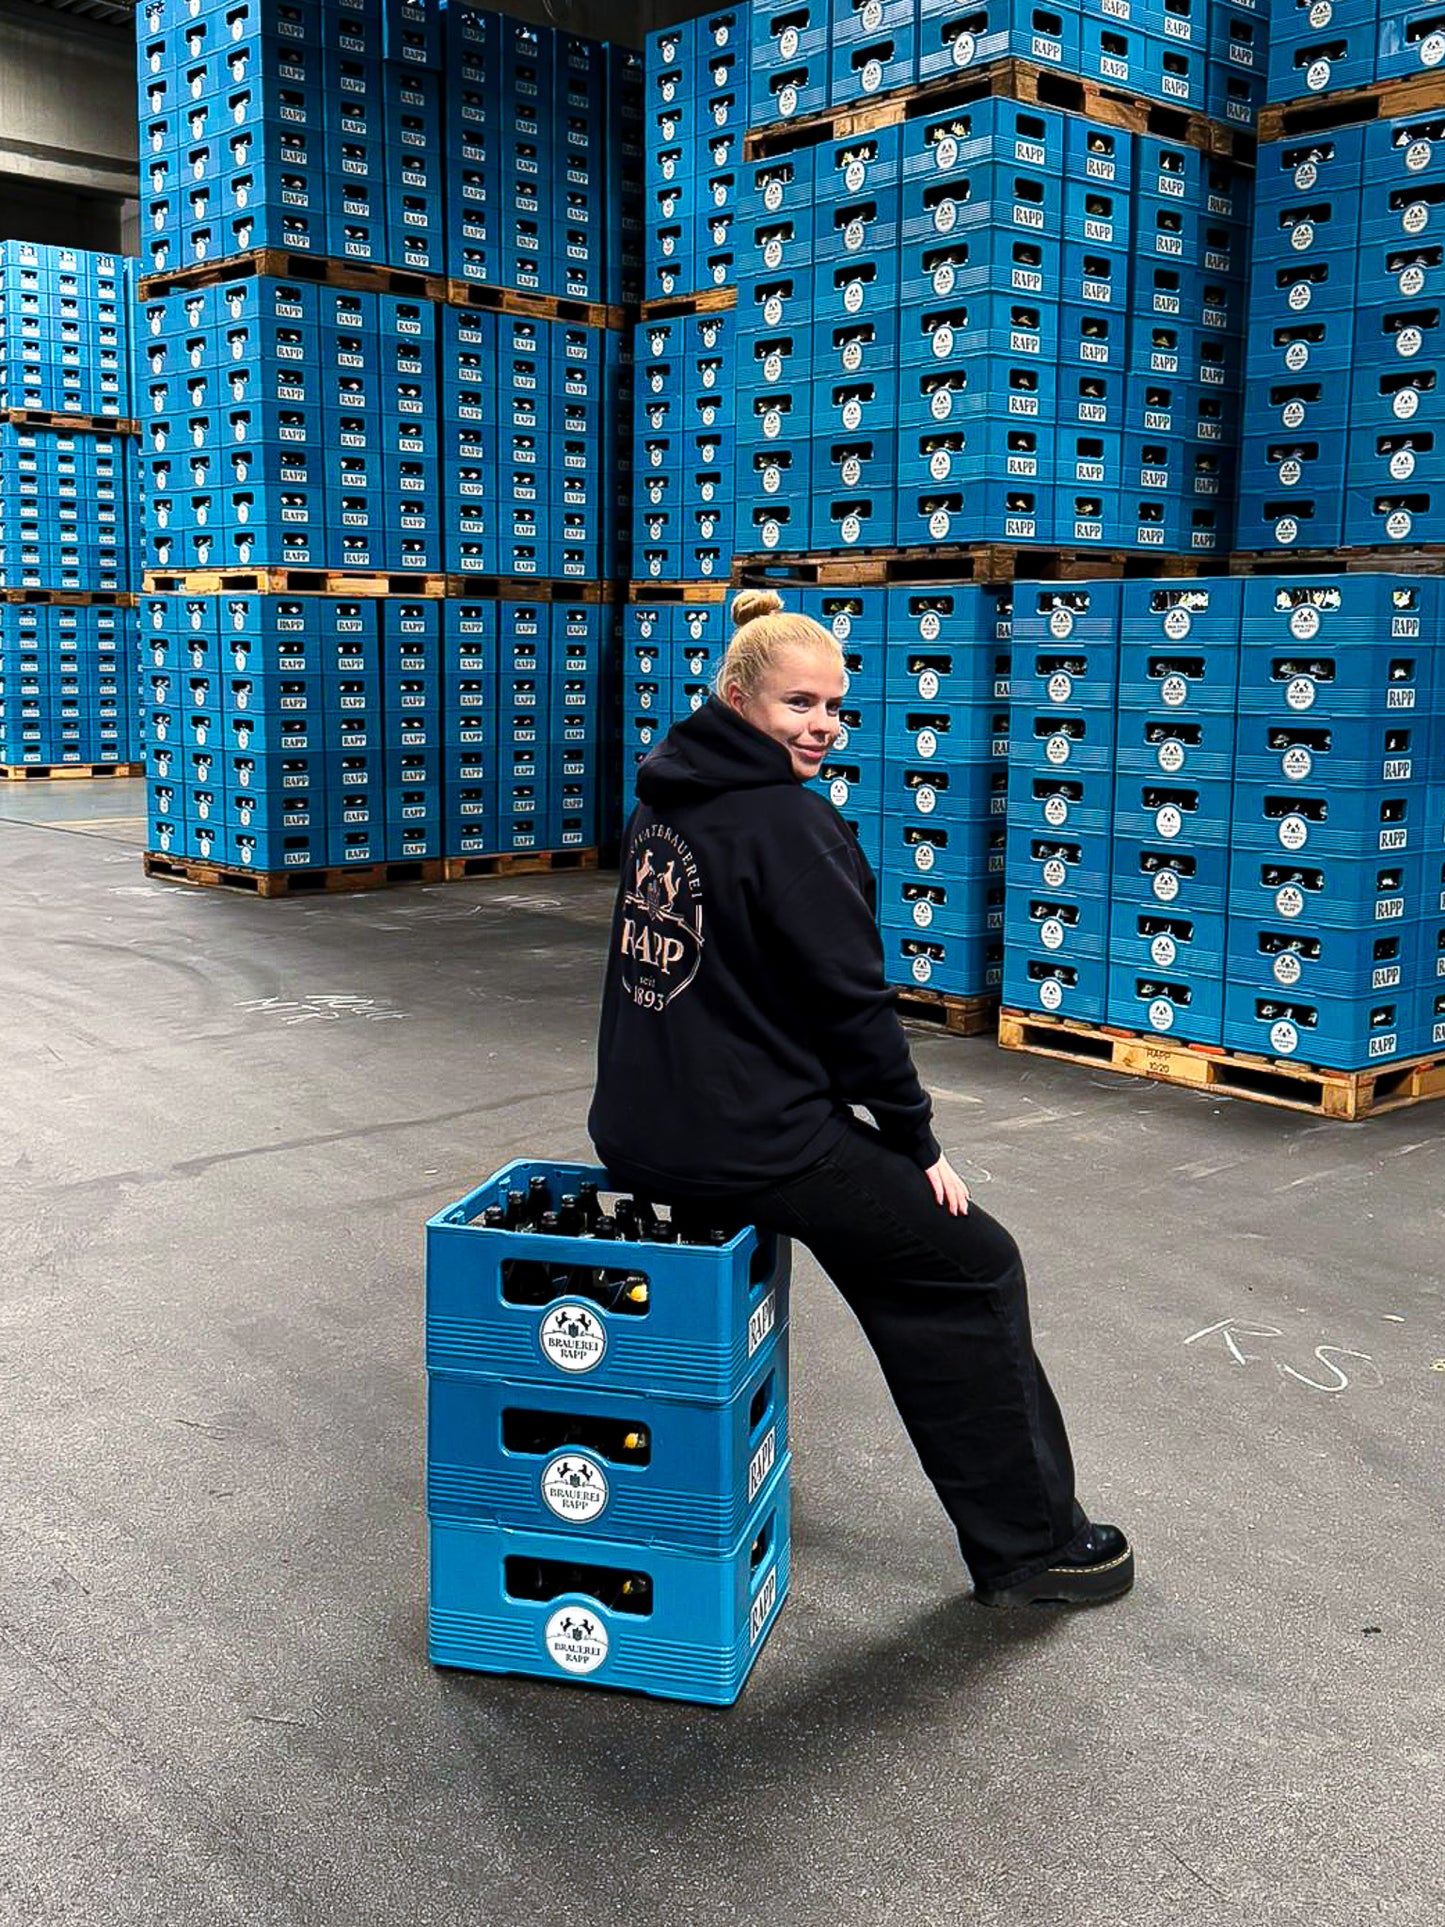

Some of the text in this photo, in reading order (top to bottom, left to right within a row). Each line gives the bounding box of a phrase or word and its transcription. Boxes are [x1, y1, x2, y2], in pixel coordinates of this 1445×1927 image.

[1102, 1, 1128, 17] RAPP
[1166, 20, 1189, 37] RAPP
[1034, 39, 1060, 58] RAPP
[1102, 59, 1127, 77] RAPP
[1164, 78, 1188, 96] RAPP
[1017, 143, 1043, 161] RAPP
[1088, 160, 1113, 178] RAPP
[1160, 178, 1183, 194] RAPP
[1015, 207, 1042, 226] RAPP
[1086, 222, 1111, 239] RAPP
[1157, 237, 1181, 253] RAPP
[1013, 271, 1041, 289] RAPP
[1084, 283, 1109, 299] RAPP
[1155, 296, 1178, 311] RAPP
[1012, 335, 1038, 351] RAPP
[1082, 344, 1107, 360] RAPP
[1152, 355, 1176, 370] RAPP
[1011, 397, 1037, 413] RAPP
[1080, 404, 1105, 420] RAPP
[1146, 414, 1170, 429] RAPP
[1009, 459, 1035, 474] RAPP
[1078, 465, 1102, 479] RAPP
[1142, 471, 1166, 486] RAPP
[1007, 520, 1034, 535] RAPP
[1077, 523, 1101, 537] RAPP
[1139, 529, 1163, 543] RAPP
[998, 623, 1011, 637] RA
[1393, 618, 1418, 636] RAPP
[996, 682, 1010, 696] RA
[1388, 690, 1414, 706] RAPP
[994, 741, 1008, 755] RA
[1385, 761, 1410, 778] RAPP
[991, 799, 1007, 813] RA
[1381, 831, 1406, 847] RAPP
[1377, 900, 1402, 918] RAPP
[621, 918, 684, 975] RAPP
[1374, 968, 1399, 986] RAPP
[634, 985, 665, 1011] 1893
[1370, 1036, 1395, 1054] RAPP
[750, 1294, 775, 1351] RAPP
[549, 1338, 598, 1351] BRAUEREI
[561, 1348, 587, 1360] RAPP
[751, 1433, 774, 1495] RAPP
[550, 1488, 599, 1502] BRAUEREI
[562, 1499, 588, 1510] RAPP
[752, 1575, 775, 1638] RAPP
[565, 1653, 590, 1664] RAPP
